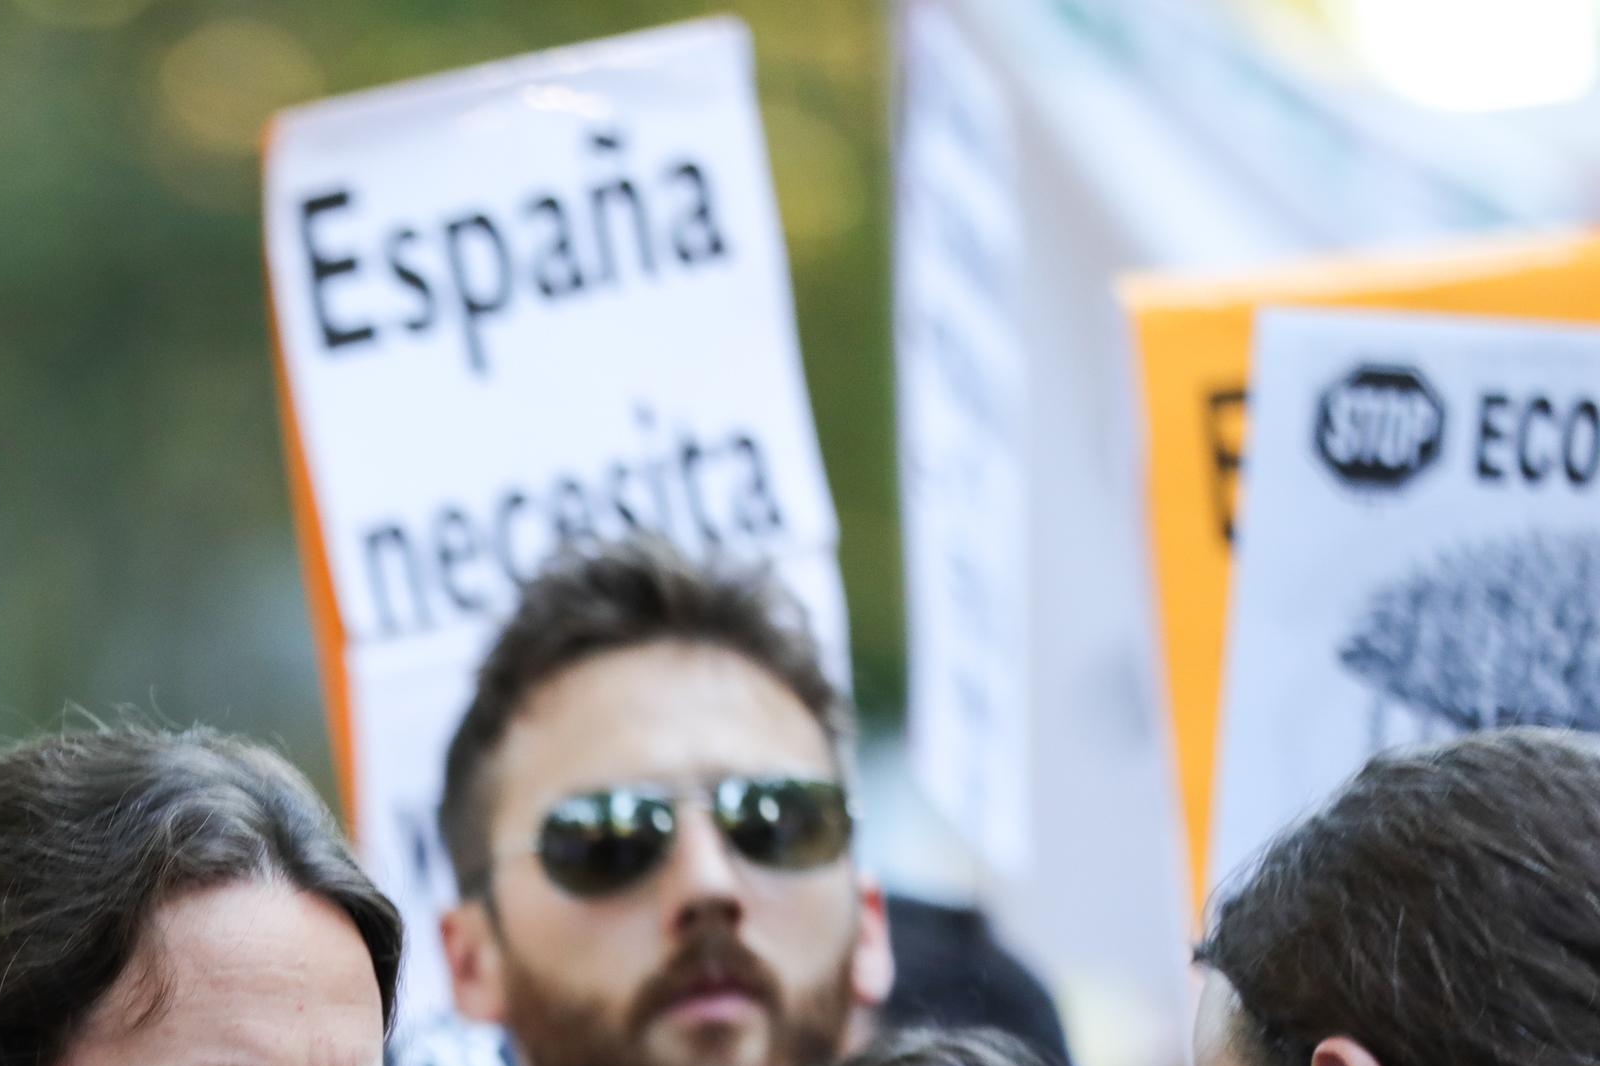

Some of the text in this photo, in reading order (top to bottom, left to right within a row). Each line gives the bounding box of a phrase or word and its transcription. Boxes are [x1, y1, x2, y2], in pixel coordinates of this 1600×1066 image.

[300, 132, 728, 374] España
[364, 403, 784, 634] necesita
[1320, 386, 1600, 486] STOP ECO
